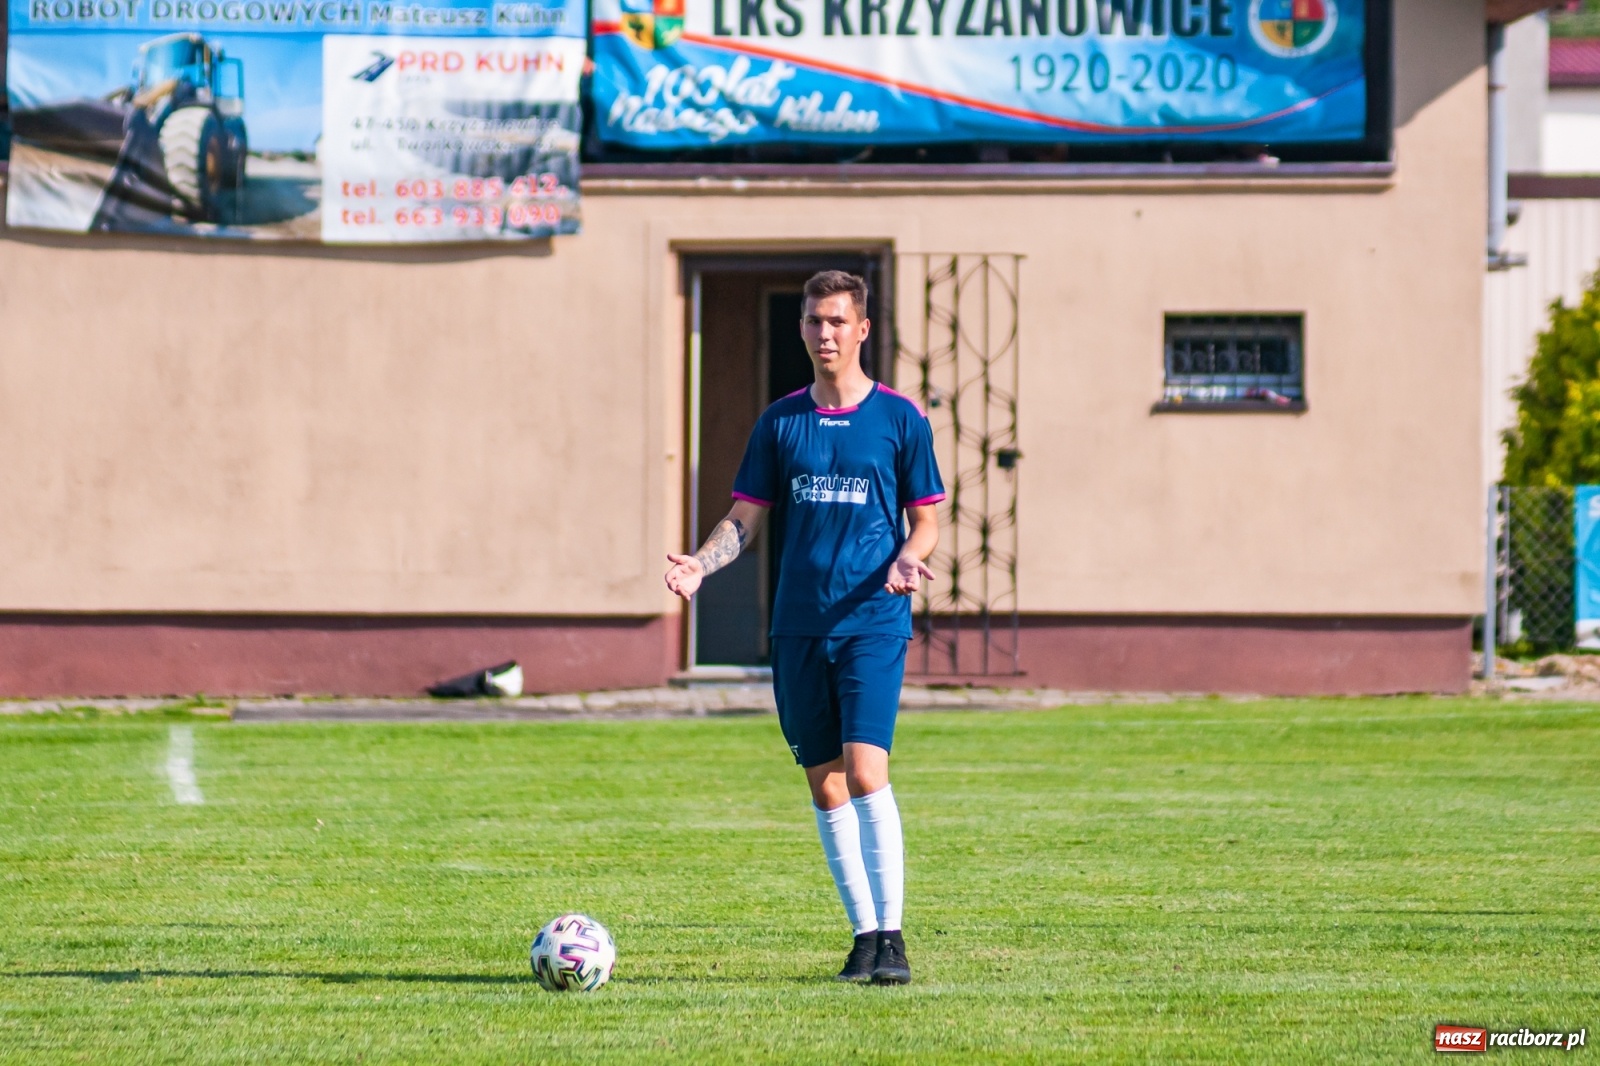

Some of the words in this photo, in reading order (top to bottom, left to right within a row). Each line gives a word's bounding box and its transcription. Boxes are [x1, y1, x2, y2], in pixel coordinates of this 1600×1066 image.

[31, 0, 140, 20] ROBOT
[151, 0, 361, 23] DROGOWYCH
[370, 5, 486, 25] Mateusz
[712, 0, 804, 37] LKS
[399, 52, 465, 73] PRD
[1010, 53, 1238, 93] 1920-2020
[774, 90, 881, 133] Klubu
[395, 179, 444, 198] 603
[395, 207, 444, 226] 663
[453, 207, 504, 225] 933
[508, 203, 561, 226] 090
